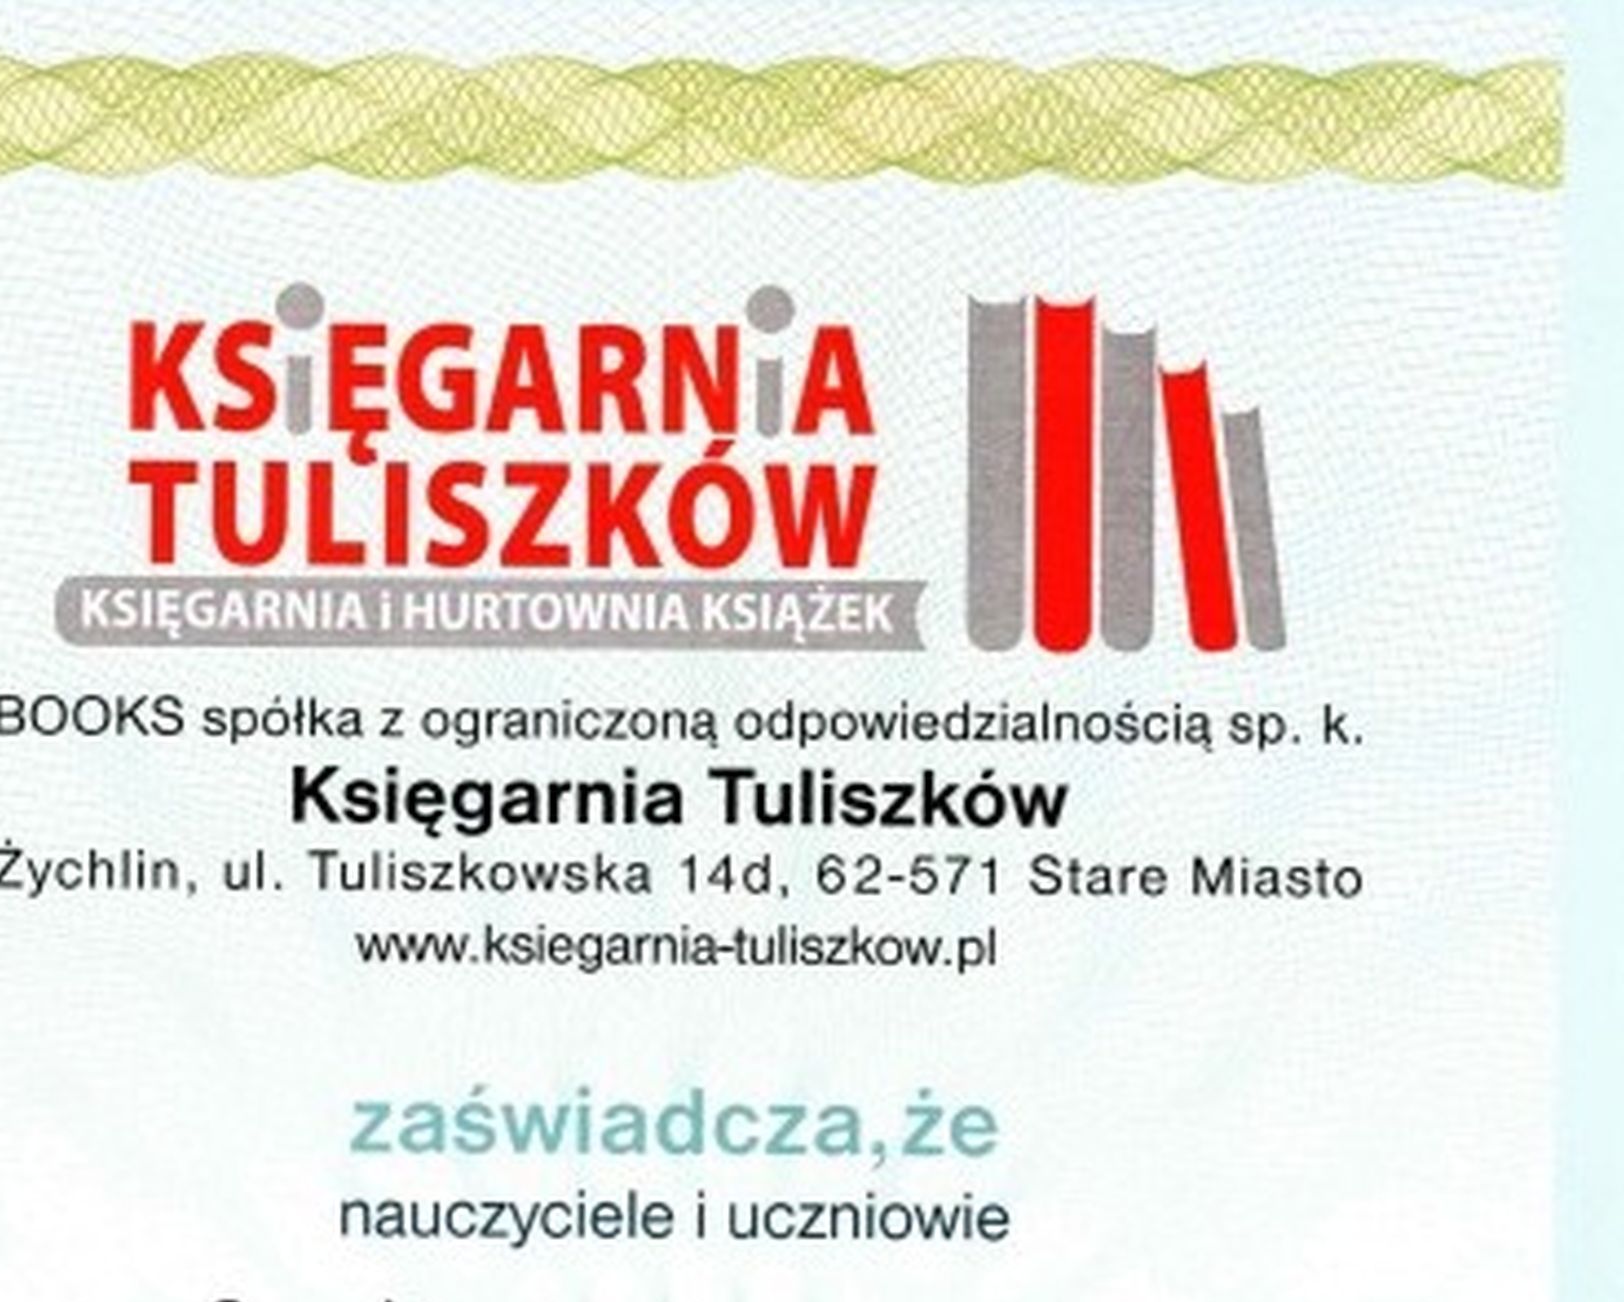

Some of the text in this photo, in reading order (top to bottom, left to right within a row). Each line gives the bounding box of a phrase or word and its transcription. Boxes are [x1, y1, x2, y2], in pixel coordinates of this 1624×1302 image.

[128, 439, 878, 570] TULISZKÓW
[79, 587, 892, 643] KSIĘGARNIA HURTOWNIA KSIĄŻEK
[202, 695, 364, 746] spółka
[380, 708, 404, 738] z
[421, 699, 718, 750] ograniczoną
[734, 700, 1212, 754] odpowiedzialnością
[1229, 712, 1300, 754] sp.
[1324, 704, 1362, 745] k.
[292, 765, 1069, 840] Księgarnia Tuliszków
[224, 849, 282, 892] ul.
[307, 849, 652, 895] Tuliszkowska
[681, 853, 788, 899] 14d,
[817, 853, 996, 896] 62-571
[1029, 853, 1167, 898] Stare
[1192, 856, 1362, 900] Miasto
[355, 922, 996, 975] www.ksiegarnia-tuliszkow.pl
[341, 1191, 1010, 1248] nauczyciele uczniowie
